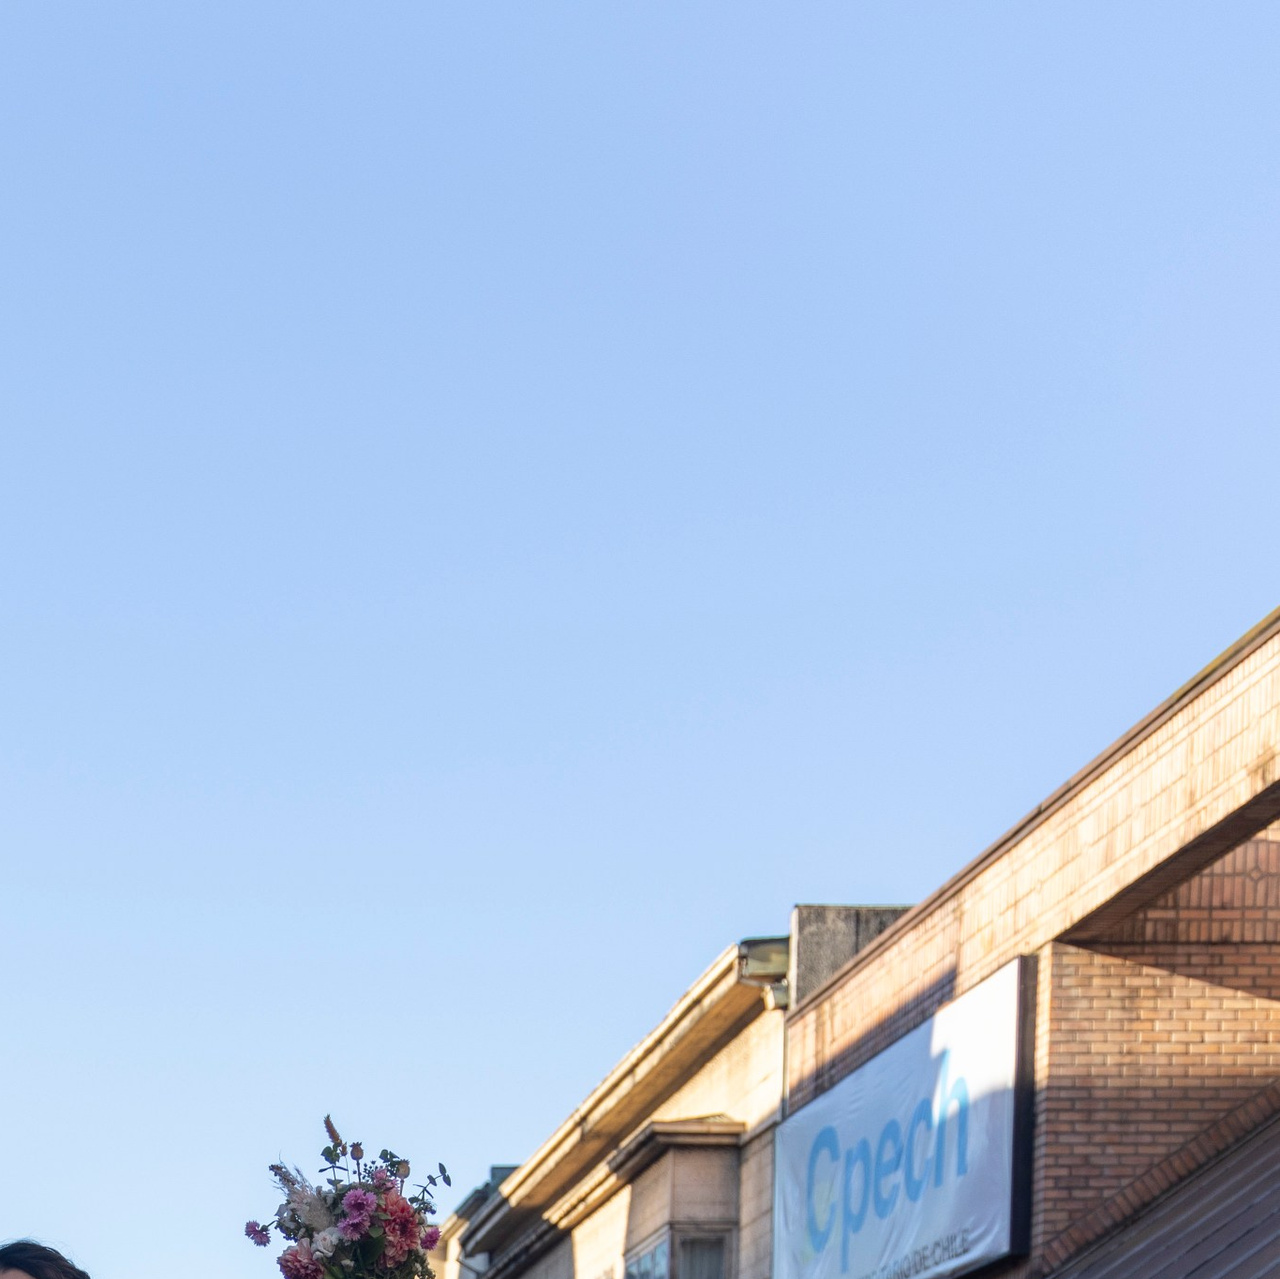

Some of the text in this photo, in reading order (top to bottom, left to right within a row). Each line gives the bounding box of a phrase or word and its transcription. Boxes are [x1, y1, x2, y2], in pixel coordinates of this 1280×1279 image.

[807, 1048, 969, 1274] Cpech
[914, 1244, 931, 1274] DE
[932, 1229, 970, 1265] CHILE
